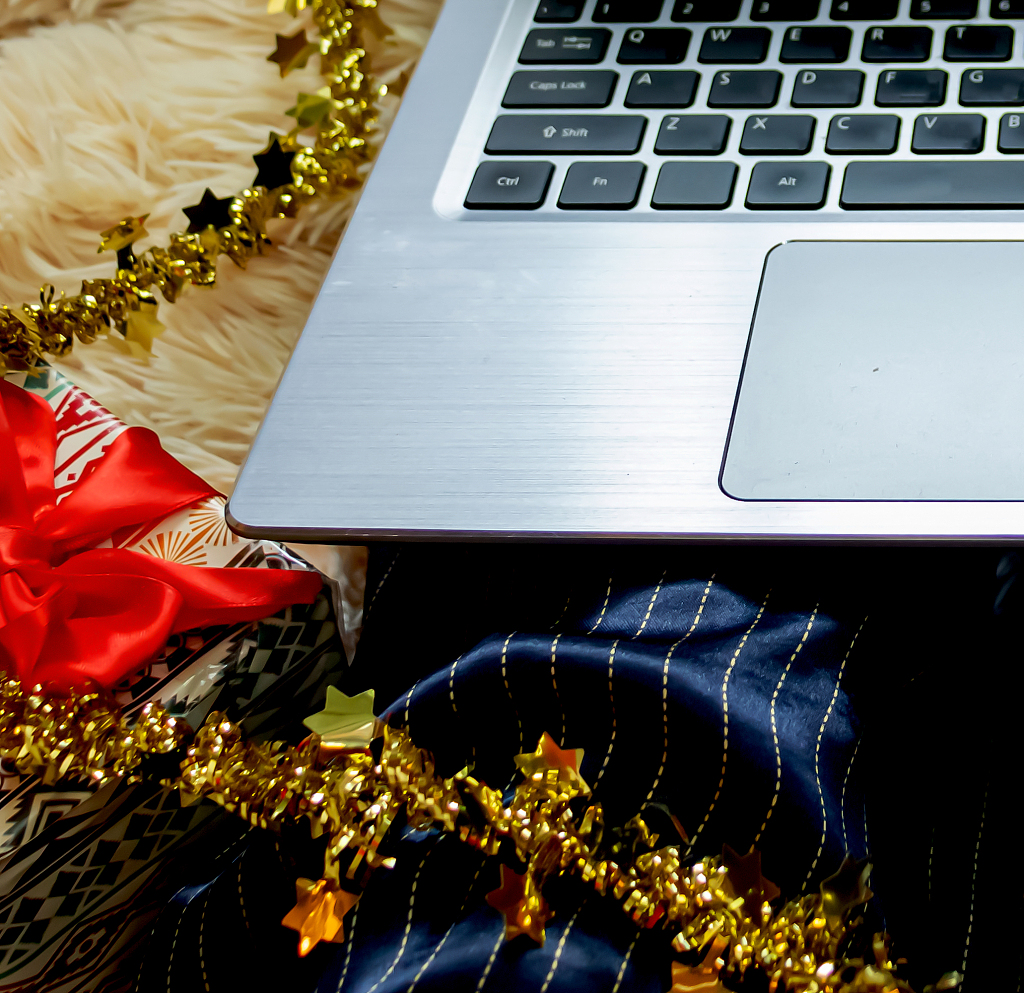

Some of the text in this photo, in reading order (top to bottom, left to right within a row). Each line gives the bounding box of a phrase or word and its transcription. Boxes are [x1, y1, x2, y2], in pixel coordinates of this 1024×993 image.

[837, 1, 849, 12] 4
[920, 0, 931, 12] 5
[998, 0, 1010, 11] 6
[628, 29, 645, 44] Q
[711, 29, 732, 41] W
[789, 28, 802, 41] E
[870, 28, 884, 40] R
[955, 26, 967, 39] T
[536, 38, 556, 48] Tab
[636, 73, 651, 85] A
[720, 73, 731, 85] S
[802, 72, 817, 84] D
[885, 71, 897, 84] F
[969, 71, 984, 83] G
[530, 80, 587, 91] Caps Lock
[666, 118, 680, 131] Z
[752, 117, 769, 130] X
[837, 117, 850, 130] C
[924, 116, 938, 129] V
[1008, 115, 1020, 128] B
[562, 127, 589, 138] Shift
[497, 176, 519, 186] Ctrl
[593, 177, 608, 186] Fn
[778, 176, 797, 186] Alt
